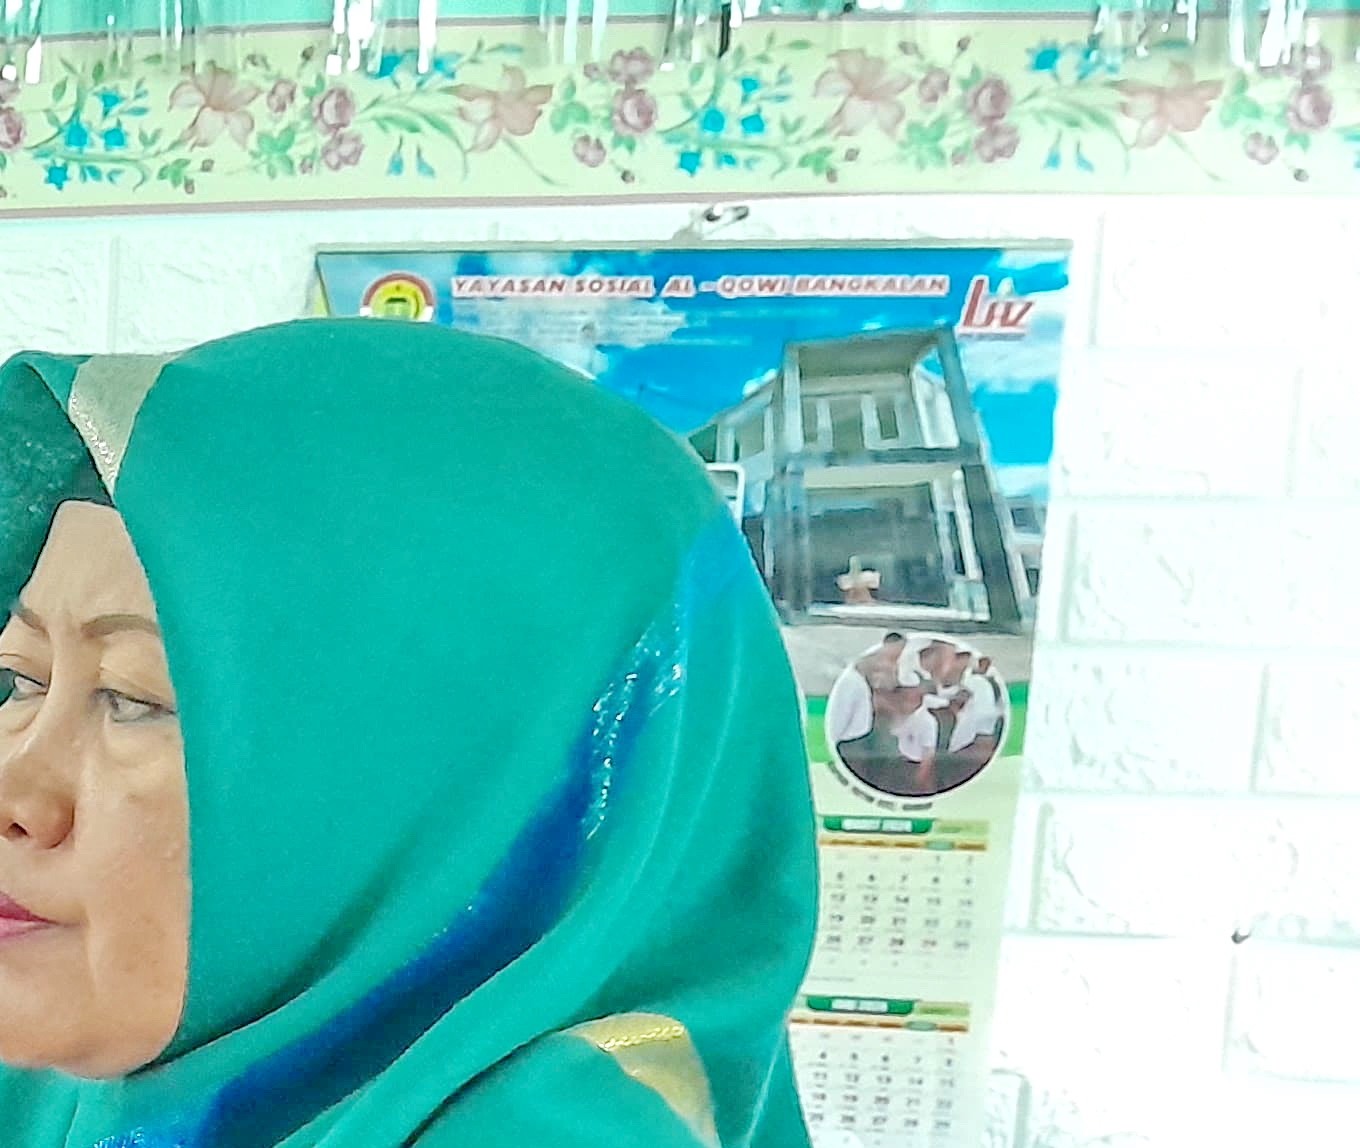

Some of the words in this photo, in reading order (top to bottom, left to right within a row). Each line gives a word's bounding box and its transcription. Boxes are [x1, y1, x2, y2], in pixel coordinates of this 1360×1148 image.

[454, 276, 566, 294] YAYASAN
[574, 276, 653, 294] SOSIAL
[666, 277, 692, 294] AL
[793, 275, 947, 294] BANGKALAN
